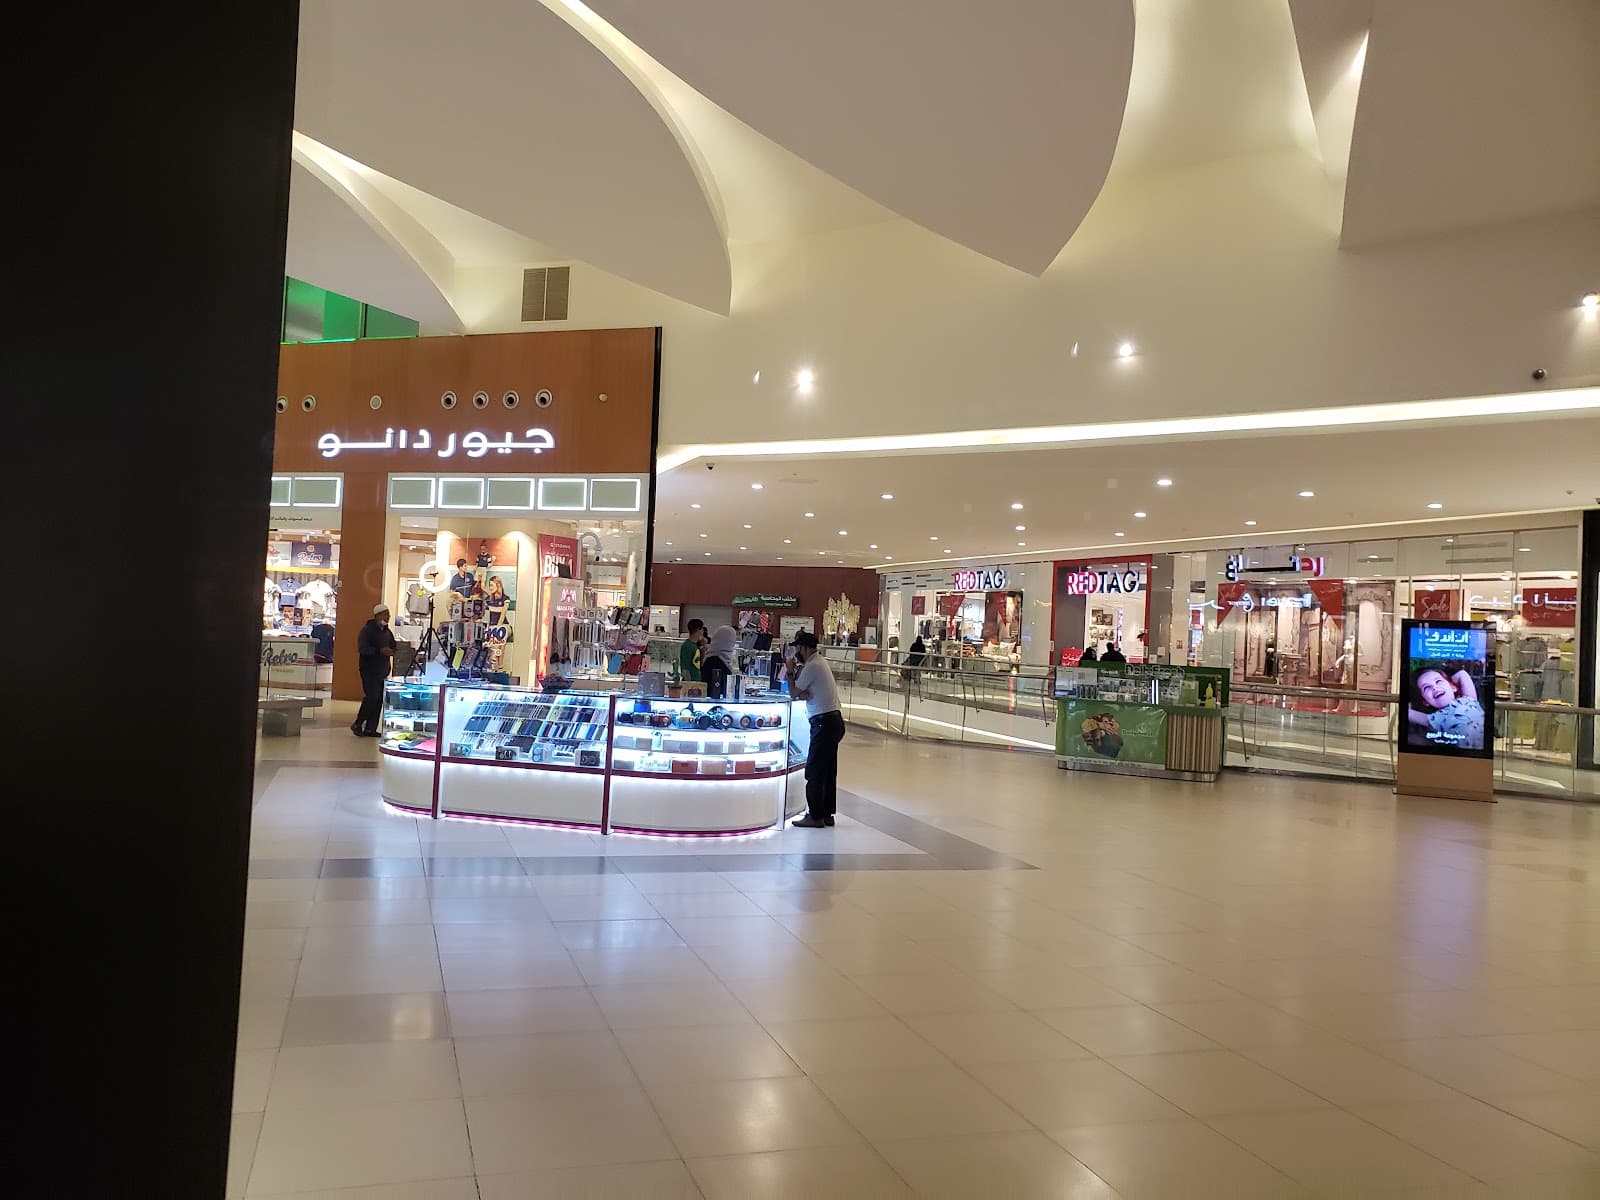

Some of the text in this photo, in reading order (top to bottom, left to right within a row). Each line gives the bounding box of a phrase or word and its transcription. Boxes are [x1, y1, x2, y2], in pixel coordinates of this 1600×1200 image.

[317, 427, 555, 458] جيوردانو
[953, 569, 1006, 590] REDTAG
[1066, 571, 1140, 594] REDTAG
[1420, 593, 1449, 619] Sale
